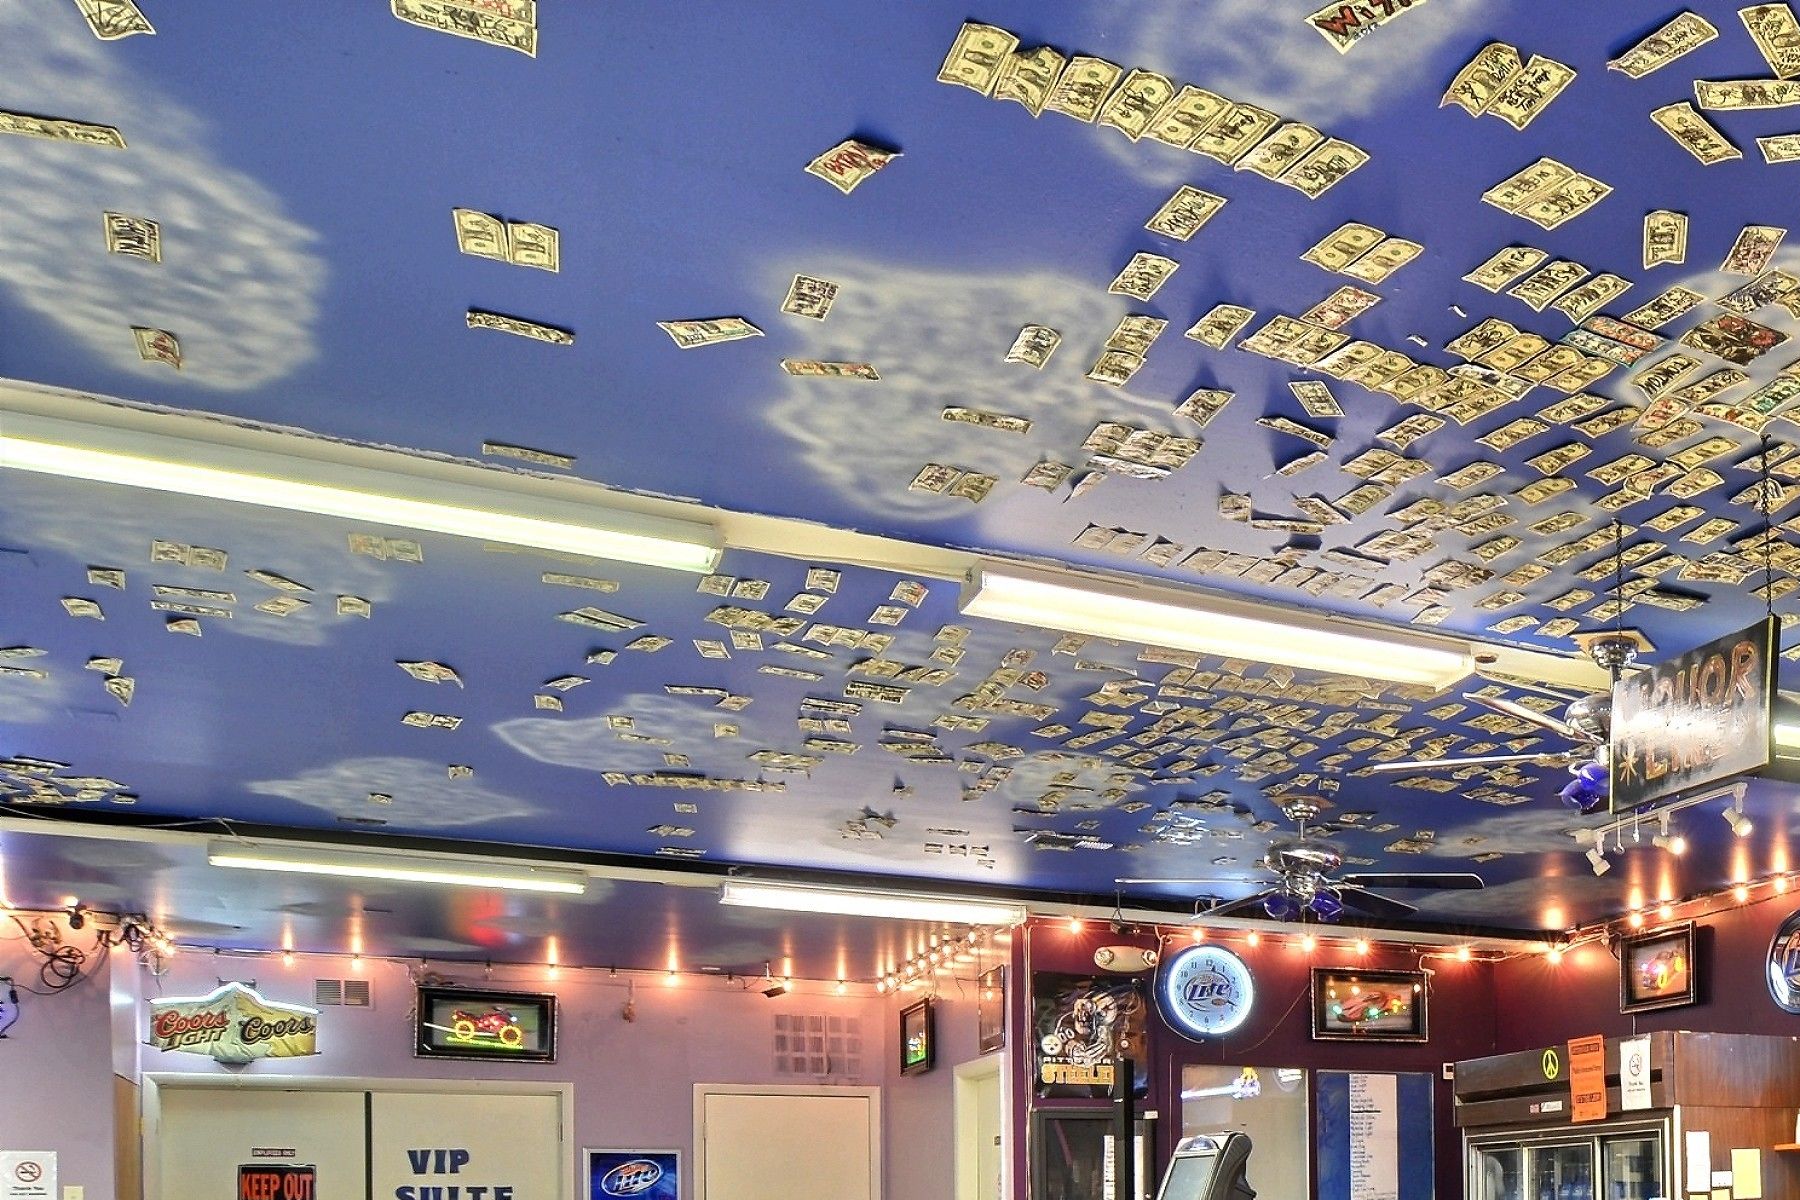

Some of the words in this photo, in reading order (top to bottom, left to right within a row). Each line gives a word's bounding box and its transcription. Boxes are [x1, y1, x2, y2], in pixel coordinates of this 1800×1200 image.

[155, 1009, 229, 1038] Coors
[239, 1016, 315, 1044] Coors
[161, 1027, 227, 1052] LIGHT
[1041, 1063, 1115, 1084] STEELE
[407, 1149, 470, 1174] VIP
[242, 1173, 280, 1200] KEEP
[284, 1172, 313, 1200] OUT
